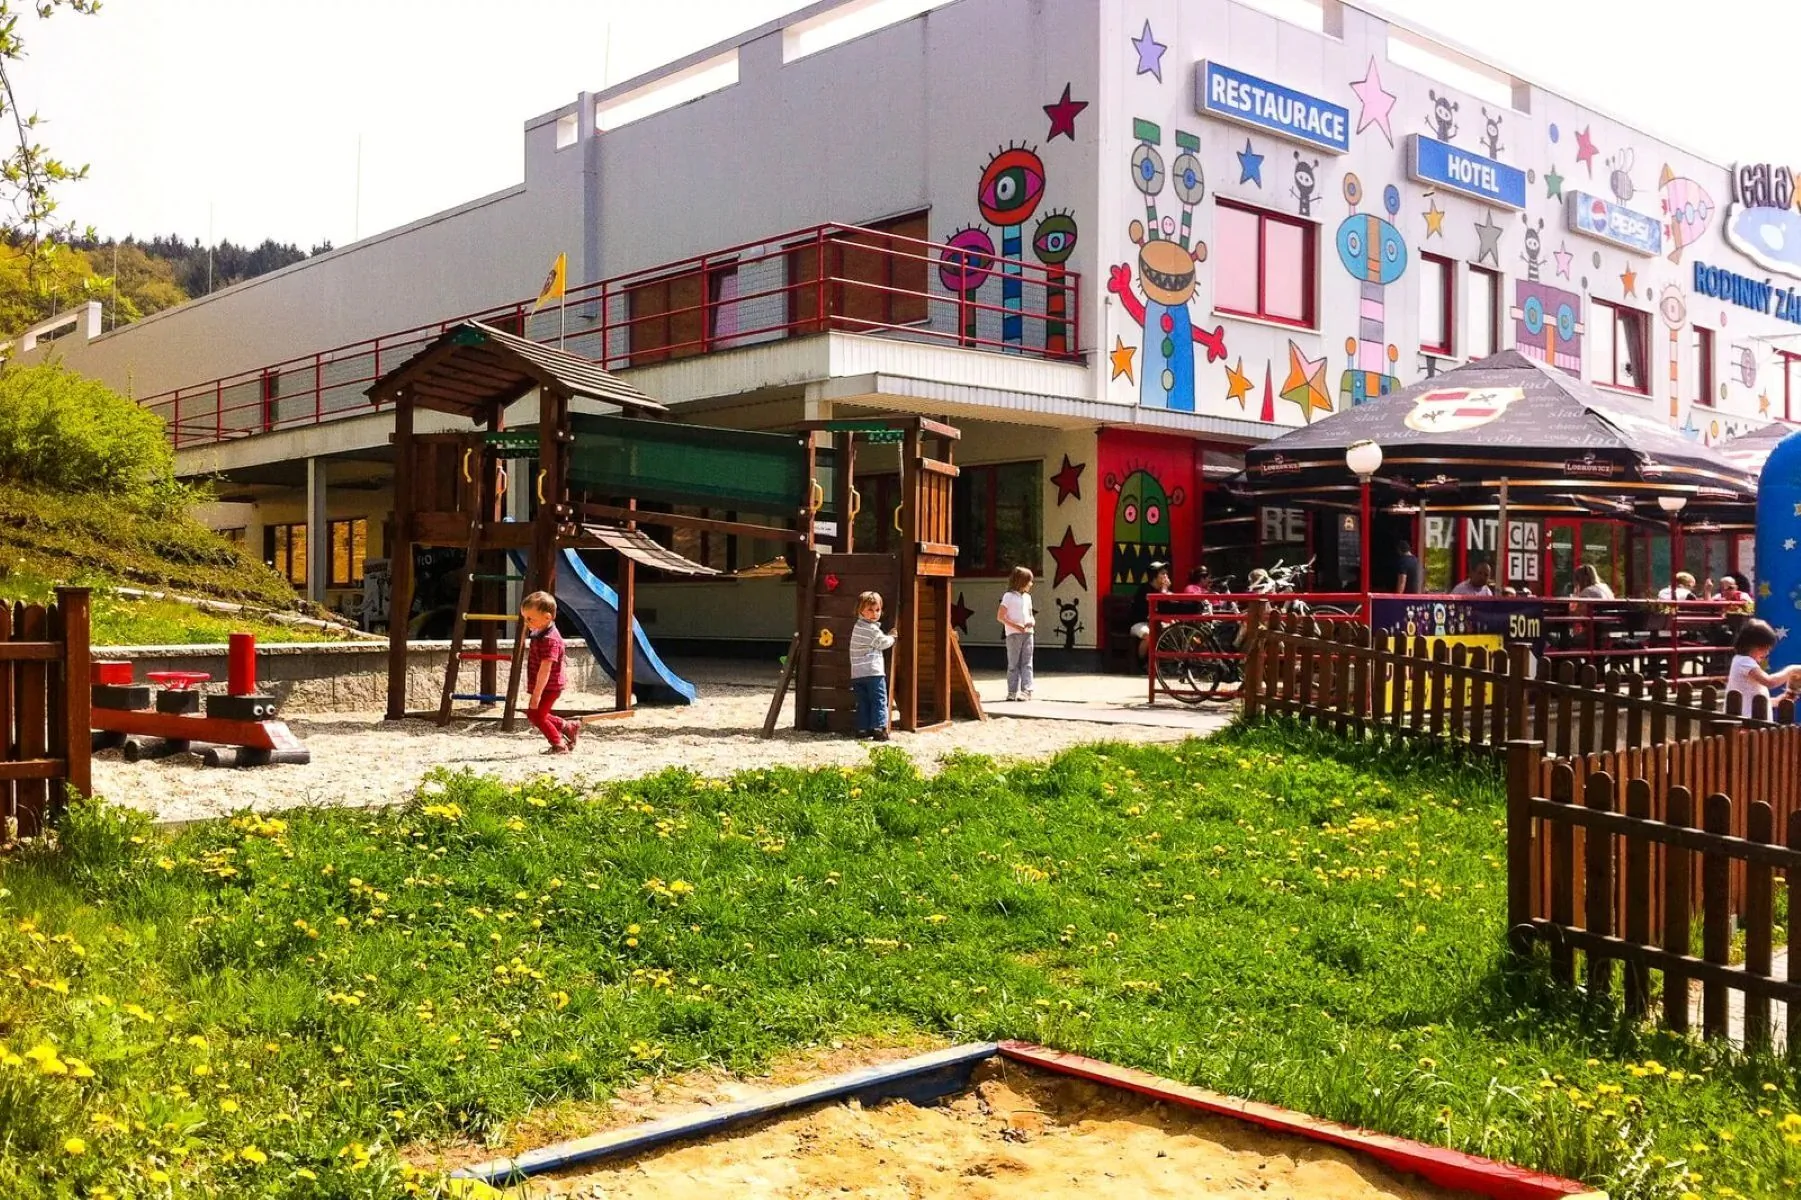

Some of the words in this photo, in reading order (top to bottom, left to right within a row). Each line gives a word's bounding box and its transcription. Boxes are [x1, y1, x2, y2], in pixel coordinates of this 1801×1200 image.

[1211, 73, 1345, 142] RESTAURACE
[1448, 154, 1499, 193] HOTEL
[1694, 260, 1773, 315] RODINNÝ
[1262, 506, 1305, 541] RE
[1467, 518, 1499, 551] NT
[1510, 525, 1537, 547] CA
[1511, 556, 1536, 577] FE
